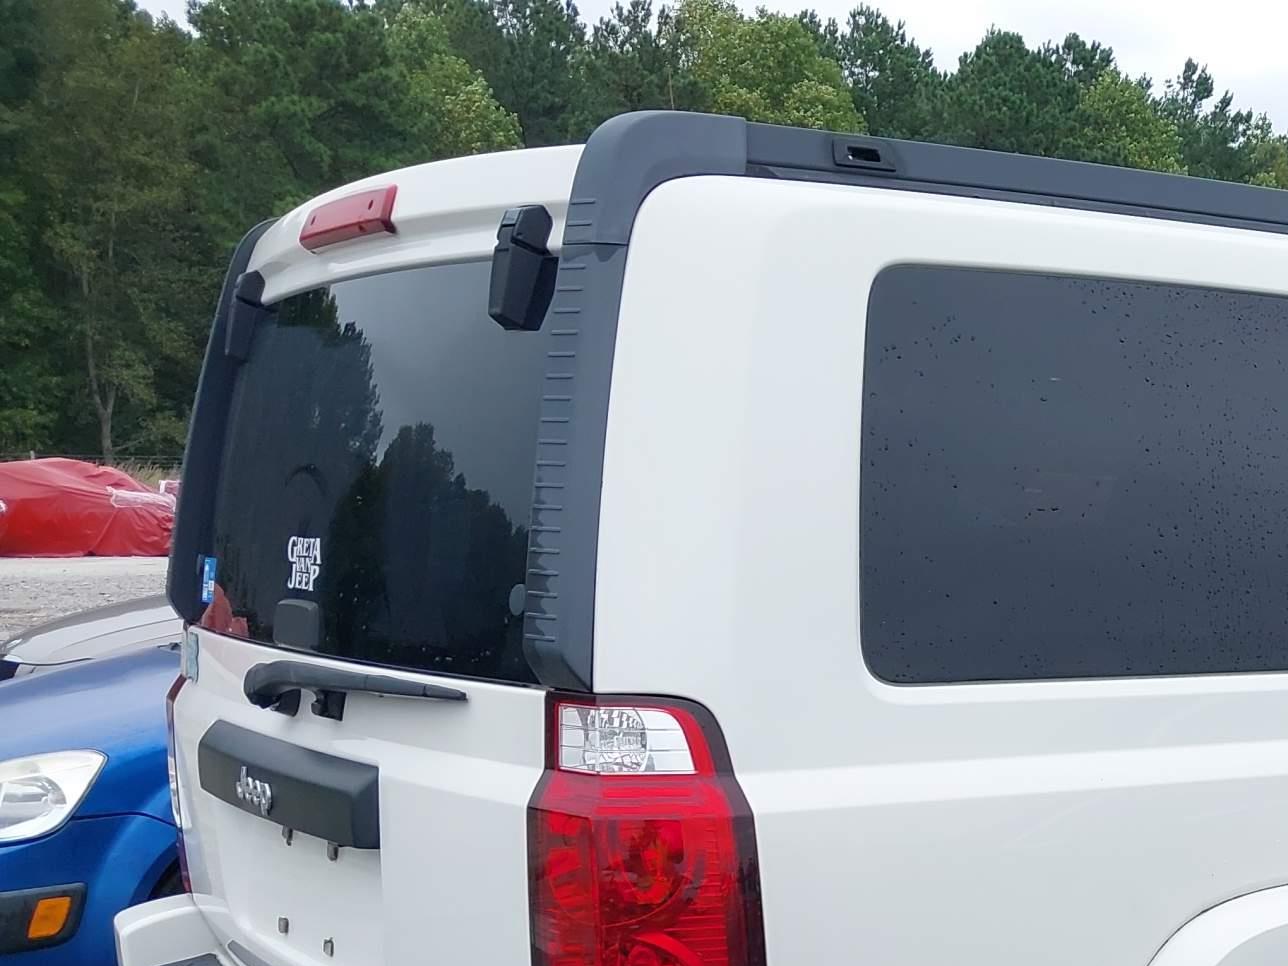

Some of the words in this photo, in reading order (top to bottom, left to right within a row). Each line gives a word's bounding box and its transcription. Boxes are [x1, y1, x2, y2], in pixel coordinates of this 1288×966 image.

[287, 536, 322, 565] GRETA
[296, 557, 312, 573] VAN
[287, 563, 320, 592] JEEP
[236, 766, 272, 816] Jeep
